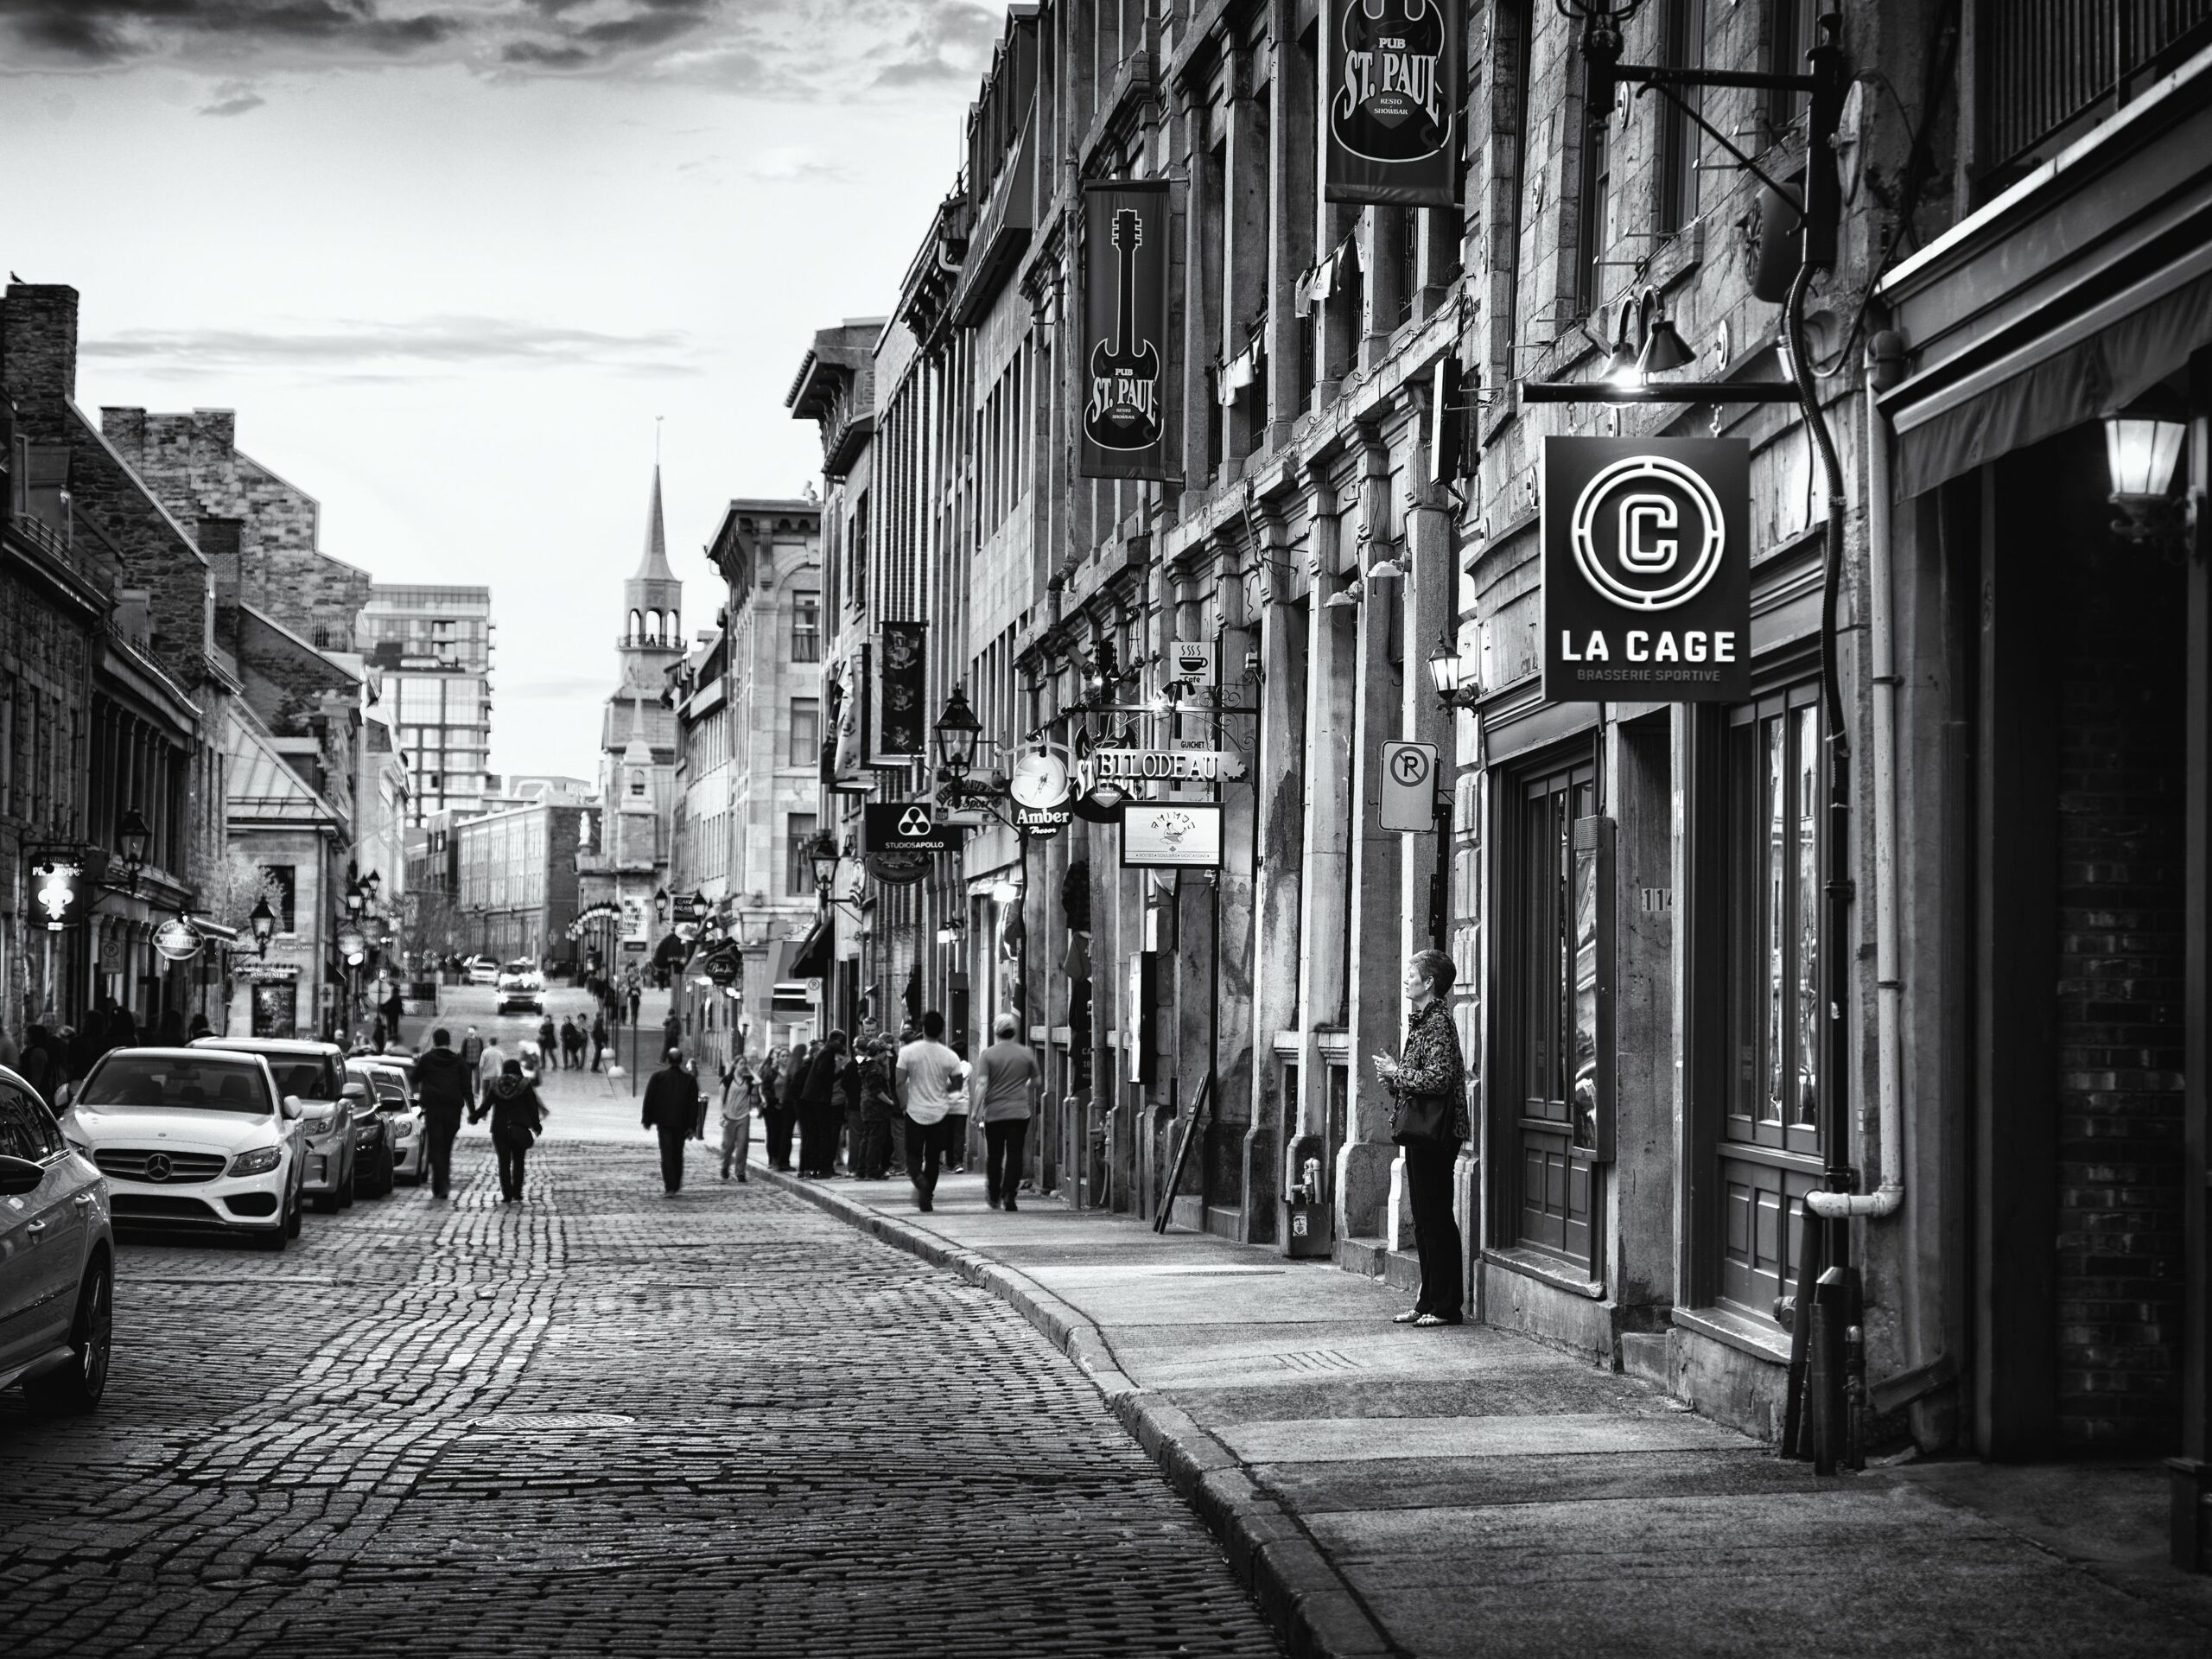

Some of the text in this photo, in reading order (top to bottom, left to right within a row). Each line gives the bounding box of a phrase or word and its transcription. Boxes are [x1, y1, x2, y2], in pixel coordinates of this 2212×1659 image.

[1379, 37, 1406, 49] PUB
[1344, 49, 1439, 128] ST. PAUL
[1092, 377, 1156, 427] ST. PAUL
[1562, 630, 1736, 663] LA CAGE
[1577, 669, 1721, 682] BRASSERIE SPORTIVE
[1180, 741, 1205, 749] GUICHET
[1100, 753, 1217, 779] BILODEAU
[1016, 808, 1070, 824] Amber
[1029, 826, 1057, 835] Tresor
